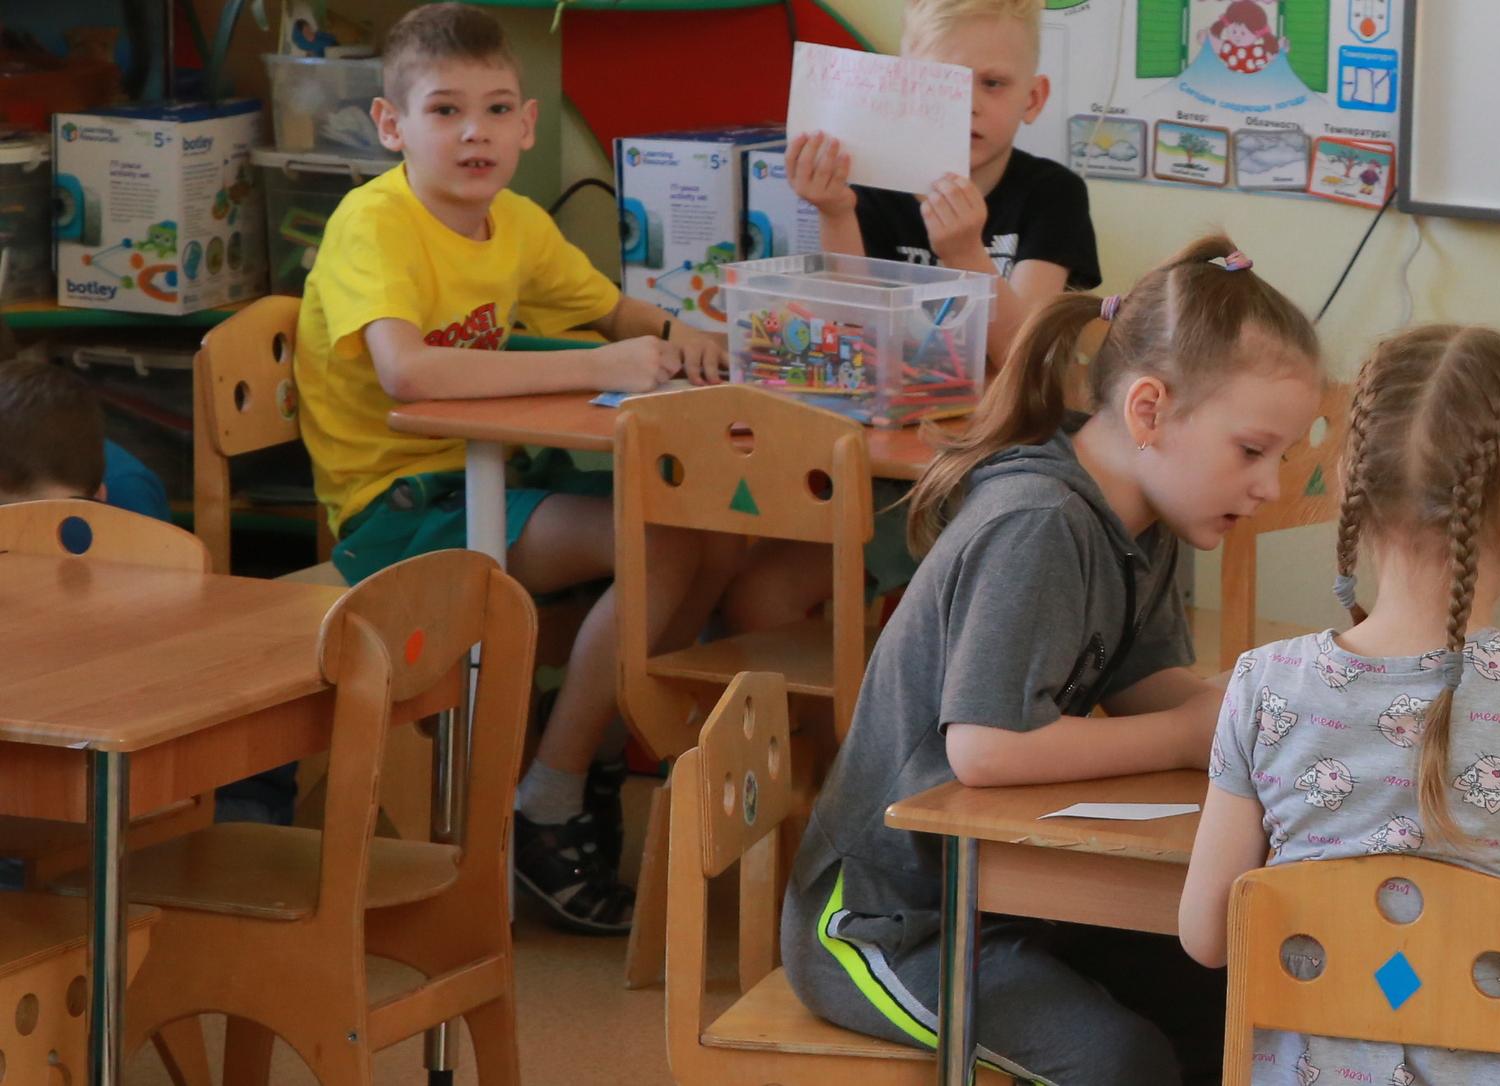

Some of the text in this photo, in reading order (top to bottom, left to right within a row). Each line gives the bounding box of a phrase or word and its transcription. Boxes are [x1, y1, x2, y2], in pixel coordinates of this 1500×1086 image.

[1090, 102, 1128, 115] Осдки:
[1177, 110, 1208, 123] Ветер:
[154, 131, 172, 148] 5+
[1324, 123, 1391, 139] Температура:
[709, 153, 729, 170] 5+
[66, 278, 118, 300] botley
[423, 302, 497, 348] ROCKET
[1269, 652, 1303, 667] meow
[1346, 656, 1388, 674] meow
[1310, 712, 1351, 731] meow
[1376, 775, 1417, 788] eow
[1335, 1065, 1373, 1084] meow
